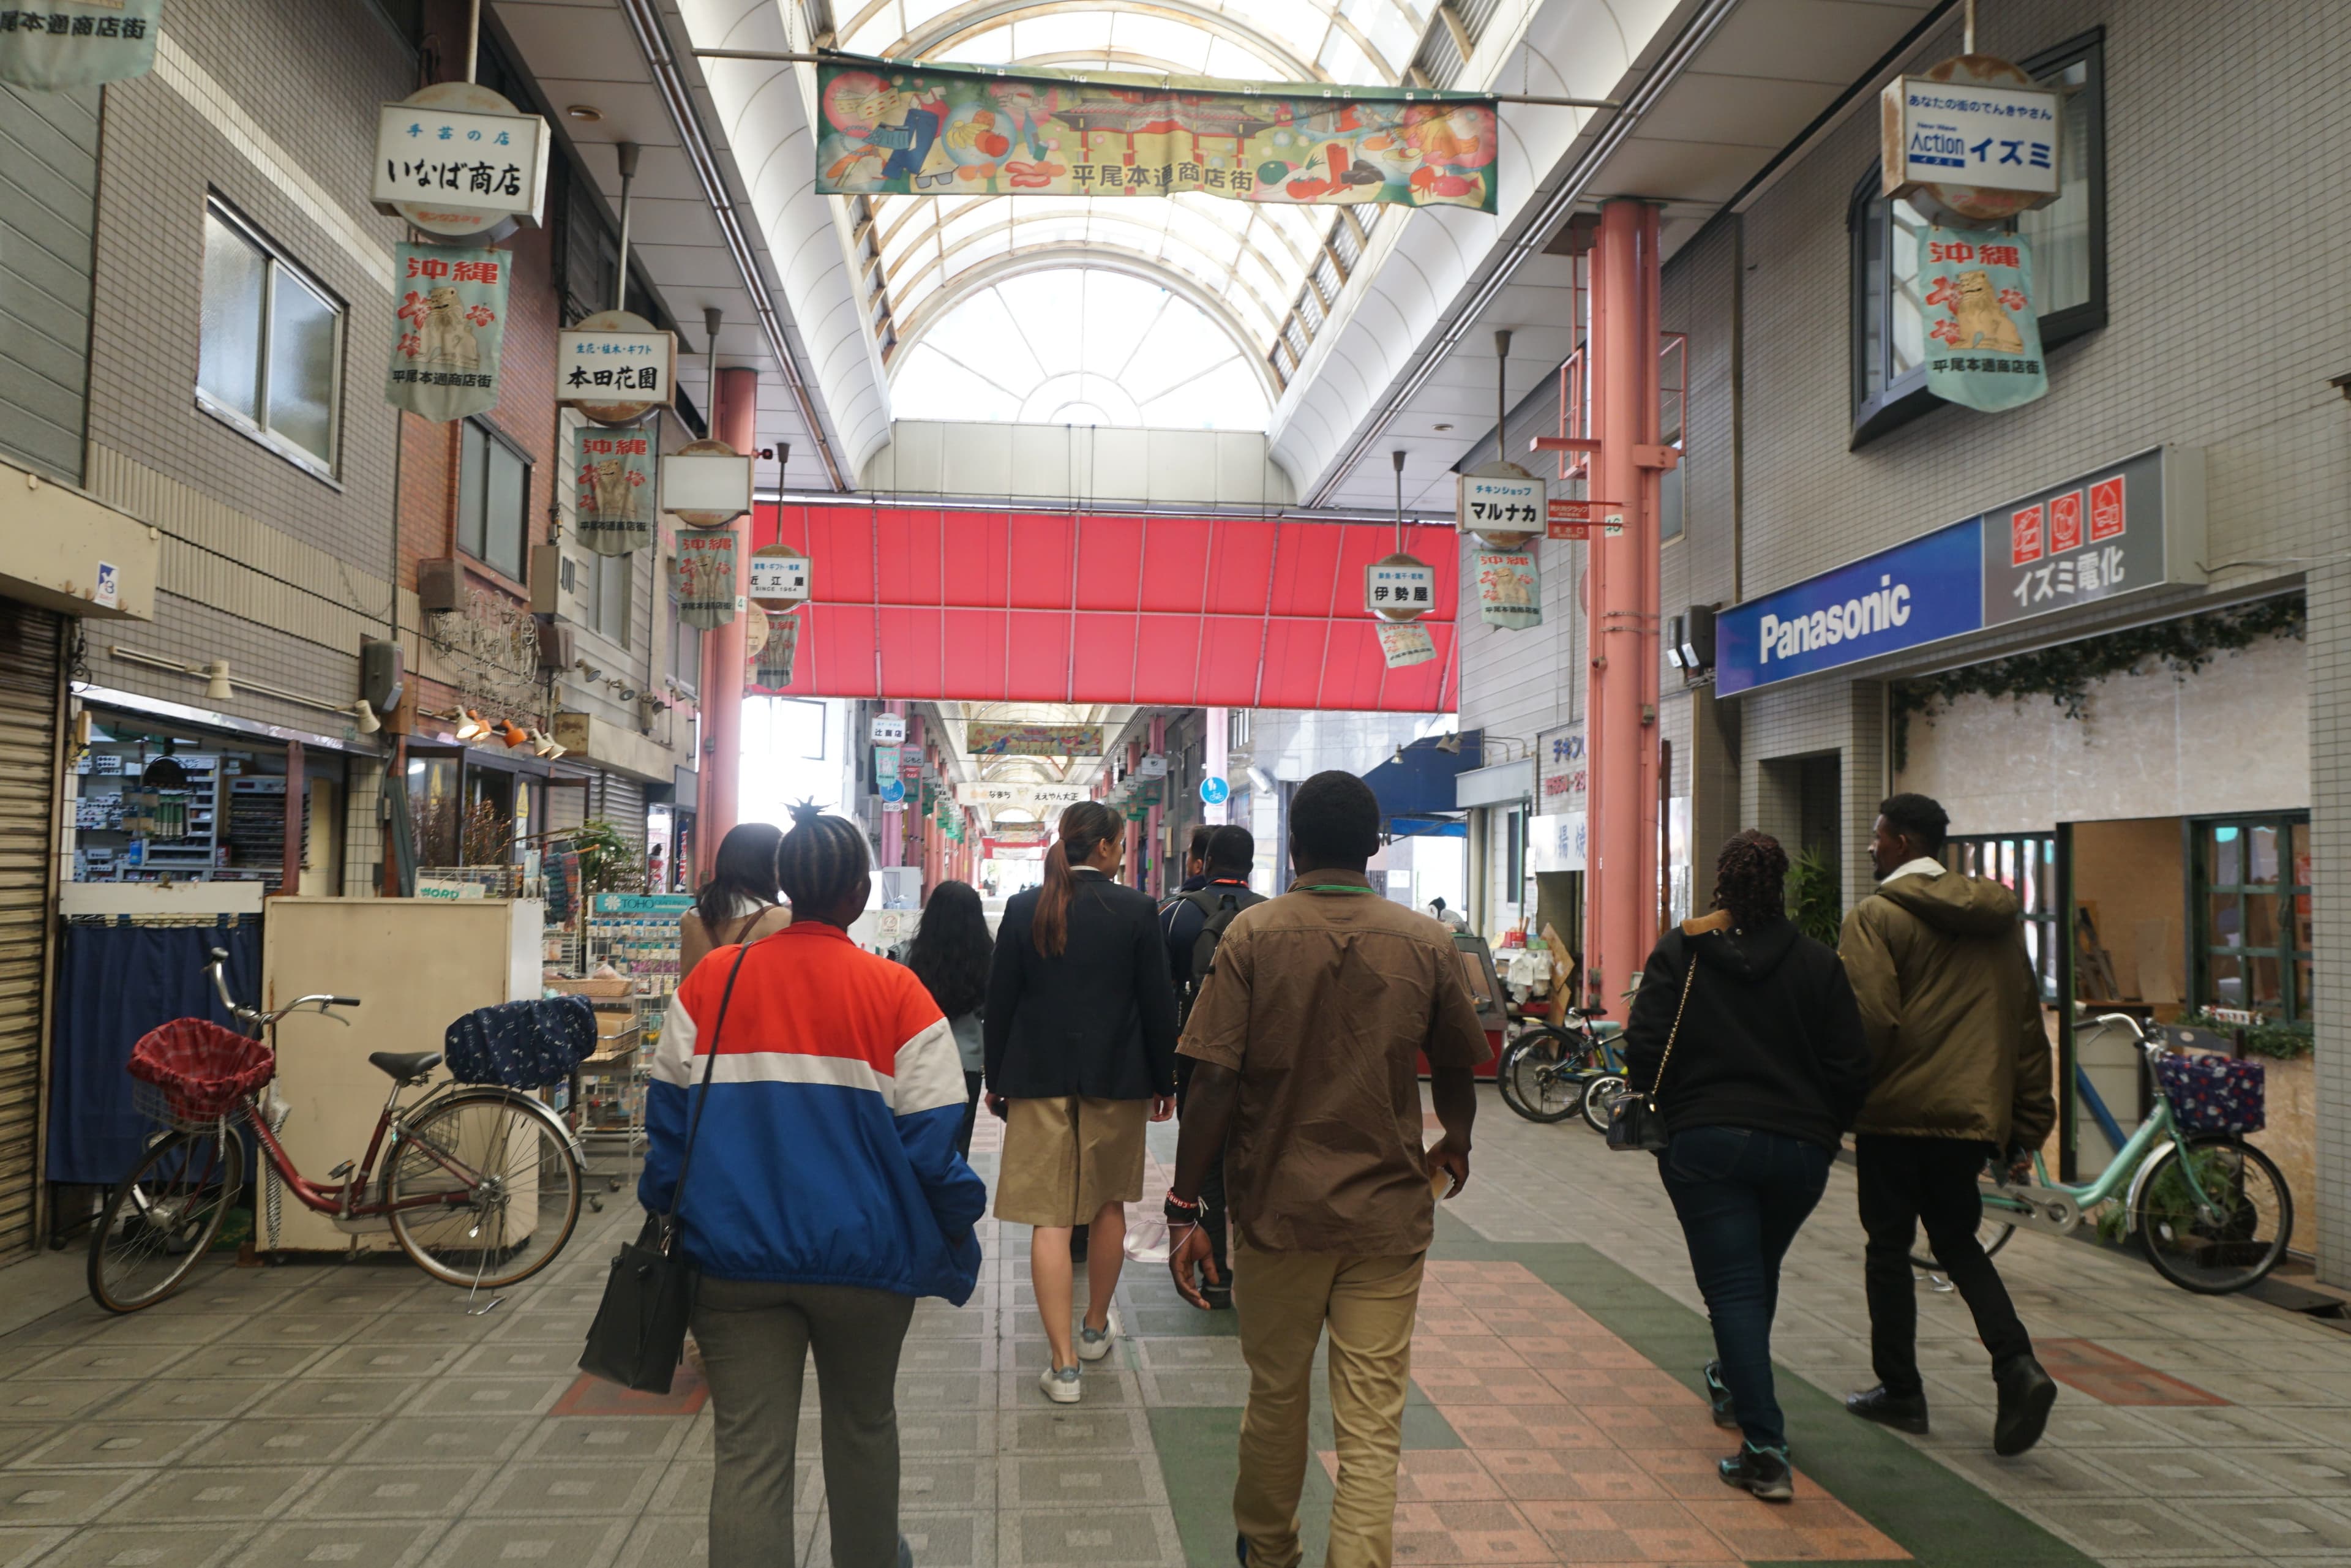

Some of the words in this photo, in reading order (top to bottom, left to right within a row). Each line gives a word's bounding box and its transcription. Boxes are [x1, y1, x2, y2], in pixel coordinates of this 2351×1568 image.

[1909, 95, 2052, 121] あなたの街のでんきやさん
[407, 124, 510, 146] 手芸の店
[1910, 132, 1965, 156] Action
[1970, 137, 2052, 170] イズミ
[388, 158, 520, 195] いなば商店
[1072, 161, 1254, 191] 平尾本通商店街
[1929, 242, 2020, 269] 沖縄
[406, 257, 498, 284] 沖縄
[392, 369, 492, 388] 平尾本通商店街
[566, 366, 658, 391] 本田花園
[583, 438, 647, 456] 沖縄
[1471, 502, 1537, 523] マルナカ
[682, 538, 732, 550] 沖縄
[751, 576, 804, 586] 近江屋
[2013, 546, 2124, 607] イズミ電化
[1374, 587, 1428, 601] 伊勢屋
[1760, 574, 1911, 664] Panasonic
[1553, 735, 1586, 762] チキン
[1035, 792, 1079, 801] ええやん大正
[622, 899, 654, 909] TOHO
